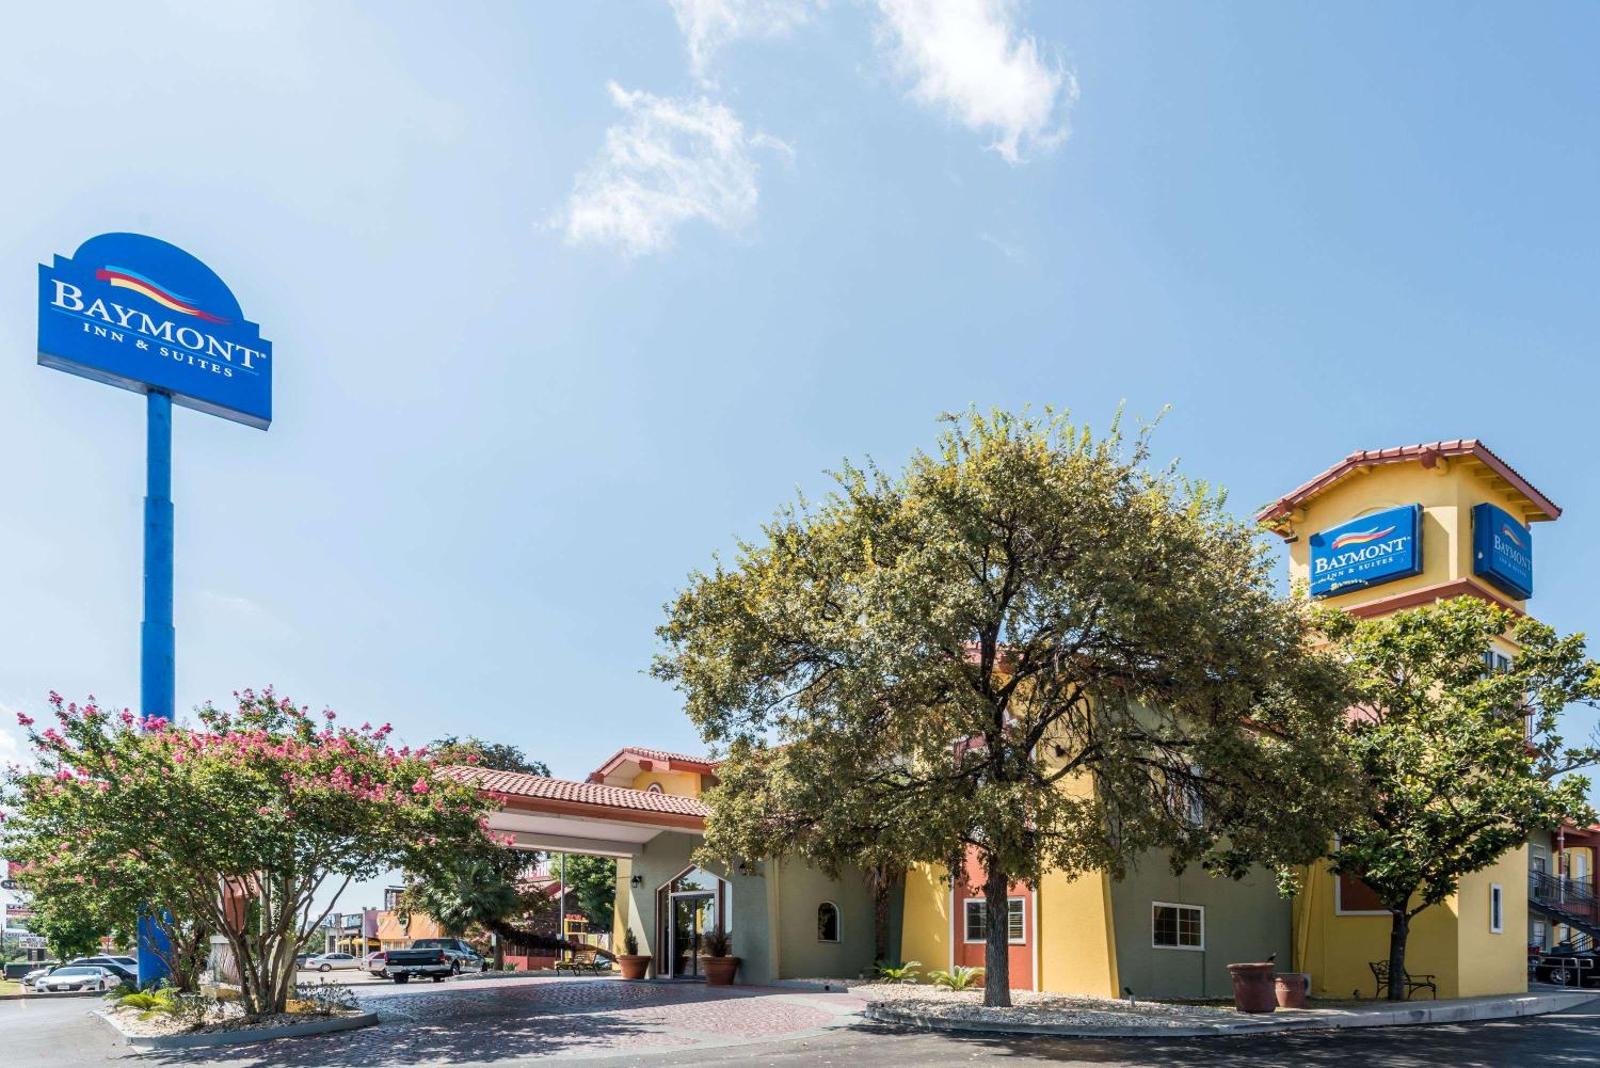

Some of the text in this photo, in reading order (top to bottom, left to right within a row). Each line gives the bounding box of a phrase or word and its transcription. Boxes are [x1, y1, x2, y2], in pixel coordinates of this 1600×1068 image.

[51, 279, 260, 369] BAYMONT
[83, 322, 233, 378] INN & SUITES
[1315, 537, 1407, 573] BAYMONT
[1327, 570, 1344, 580] INN
